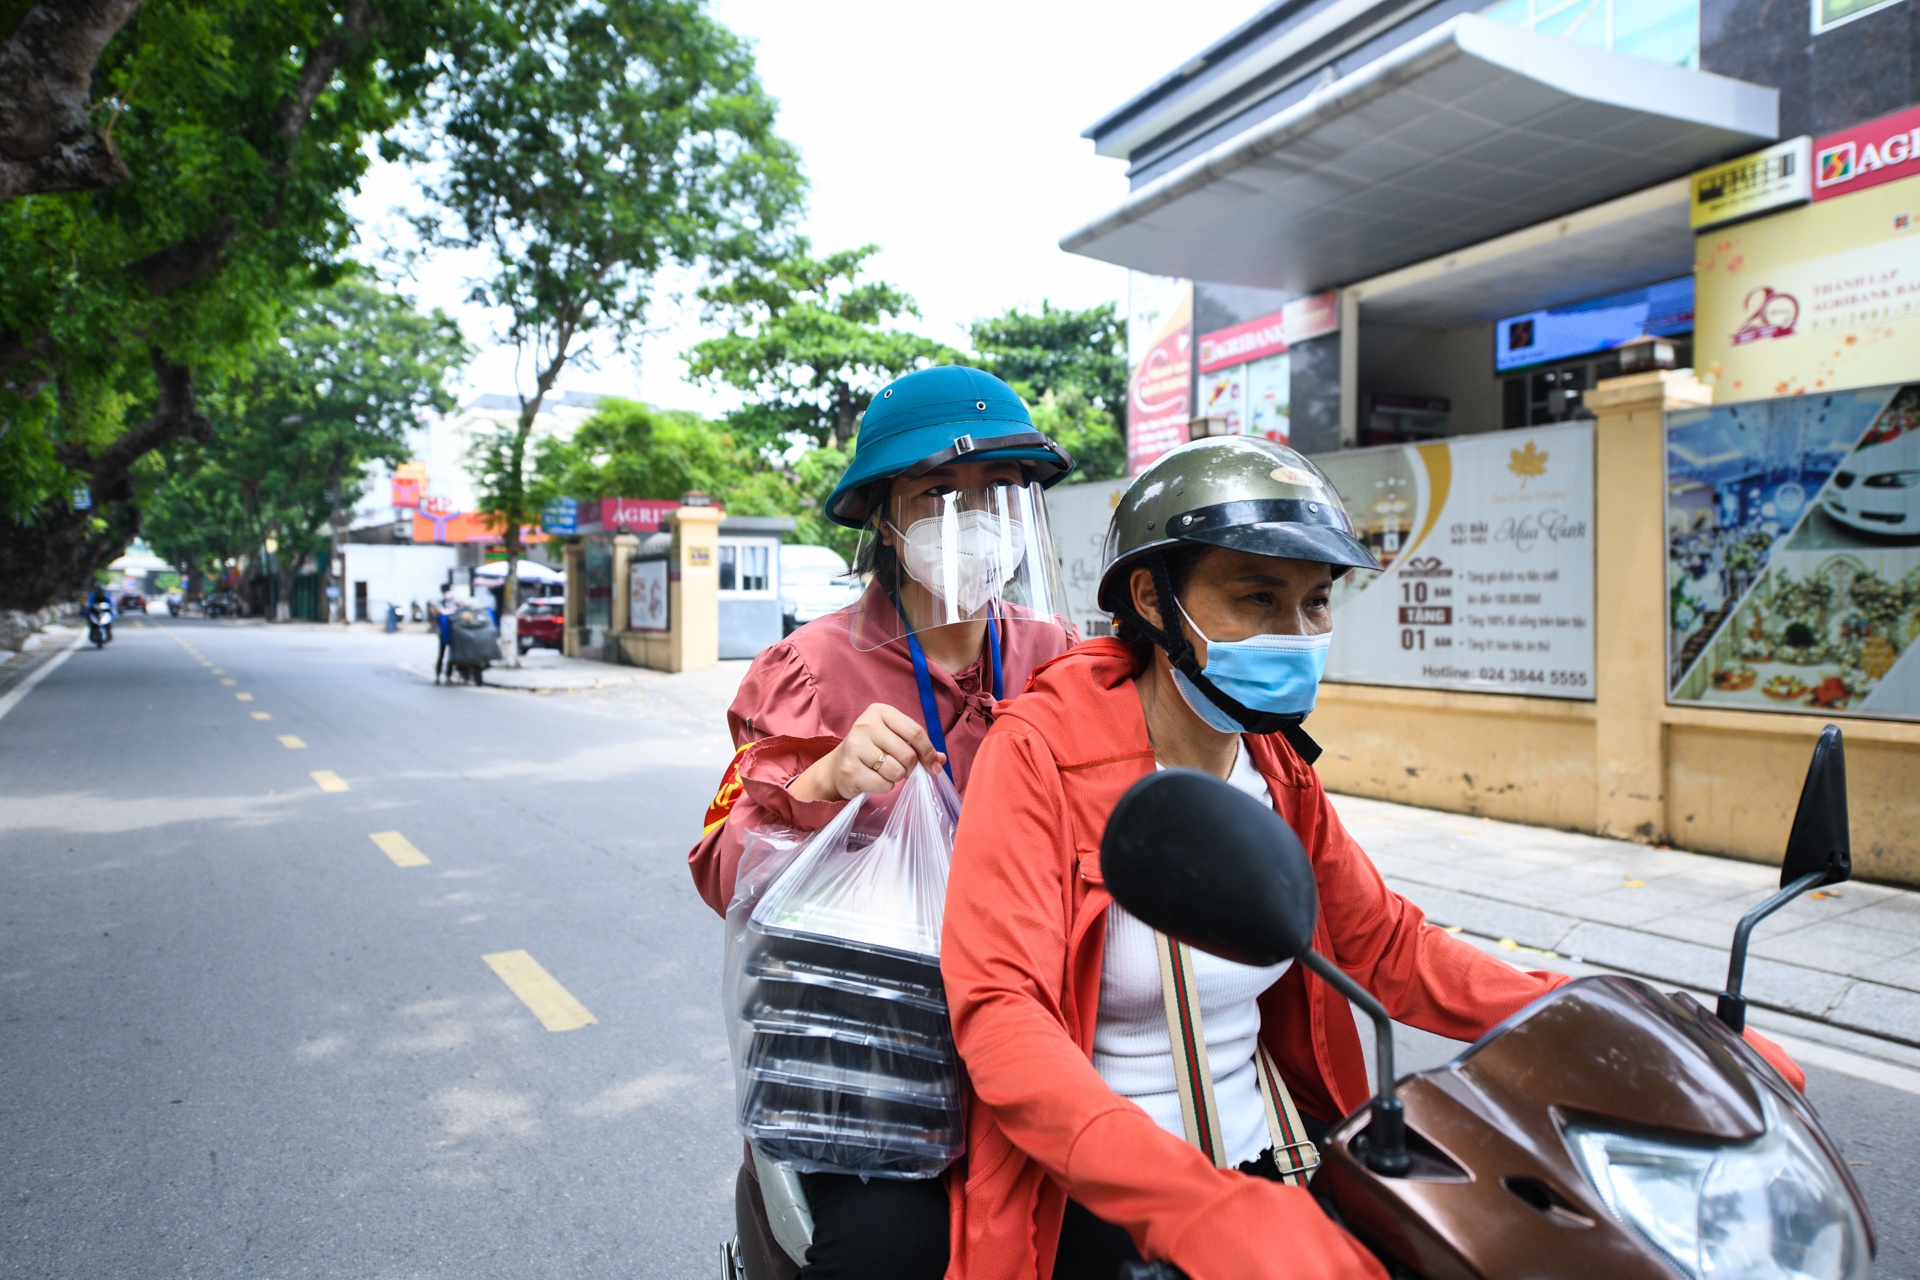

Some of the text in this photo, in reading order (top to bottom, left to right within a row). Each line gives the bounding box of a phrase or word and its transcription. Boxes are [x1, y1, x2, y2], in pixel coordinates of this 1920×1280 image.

[1401, 581, 1427, 603] 10
[1401, 628, 1425, 651] 01
[1422, 664, 1588, 687] Hotline: 024 3844 5555
